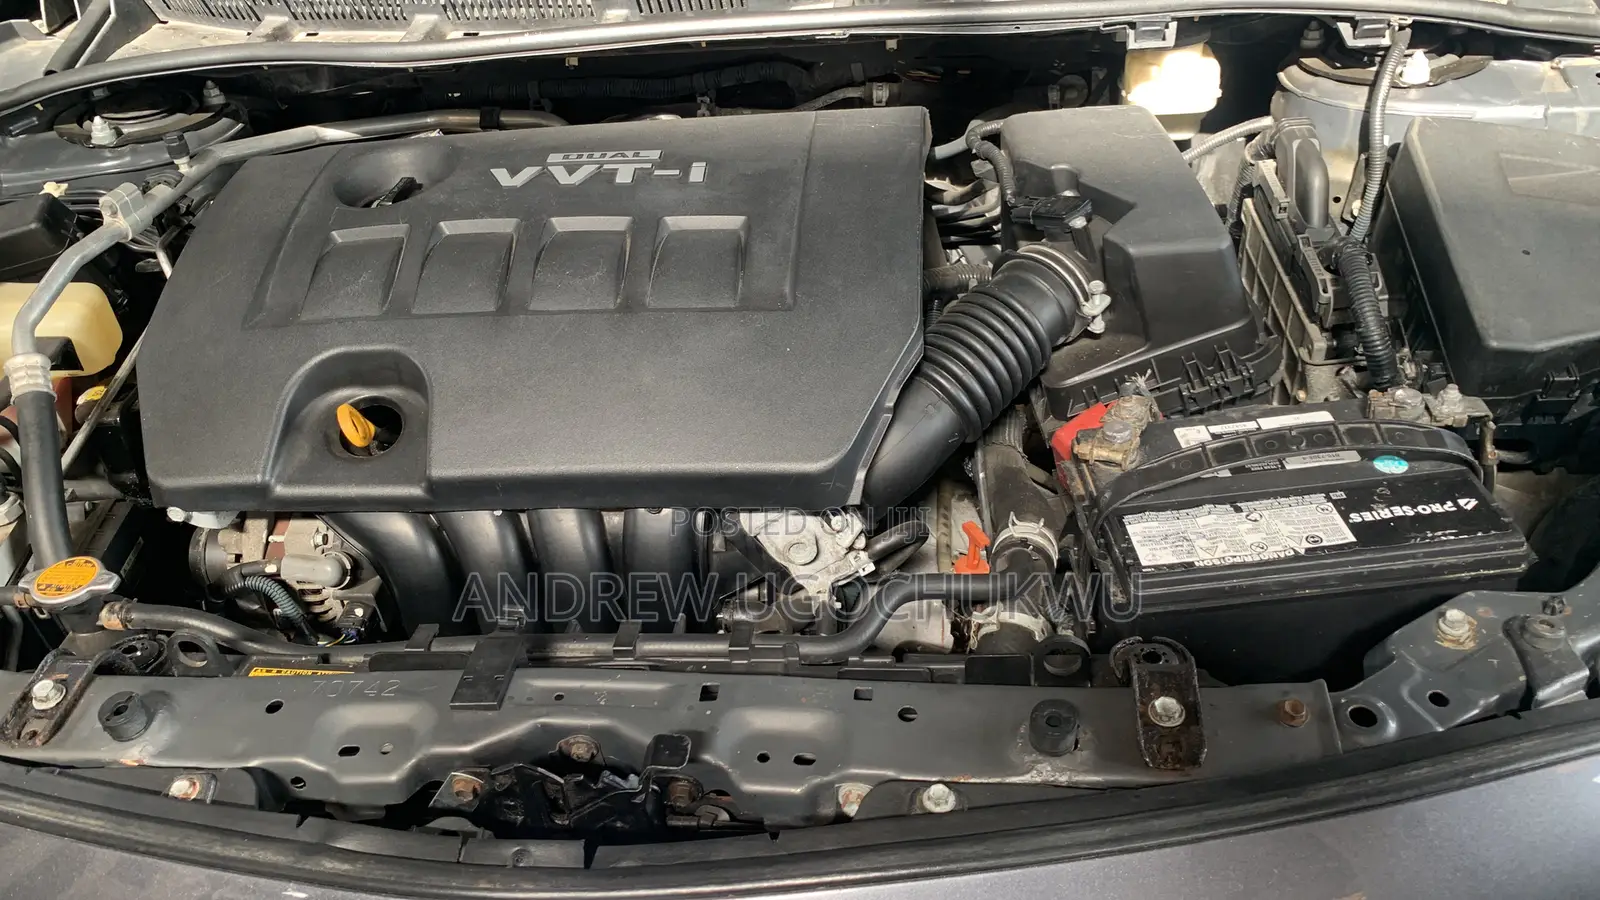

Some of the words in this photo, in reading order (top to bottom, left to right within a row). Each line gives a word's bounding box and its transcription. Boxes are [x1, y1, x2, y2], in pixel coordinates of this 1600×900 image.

[562, 152, 651, 160] DUAL
[490, 161, 707, 187] VVT-i
[1193, 548, 1295, 567] DANGER/POISON
